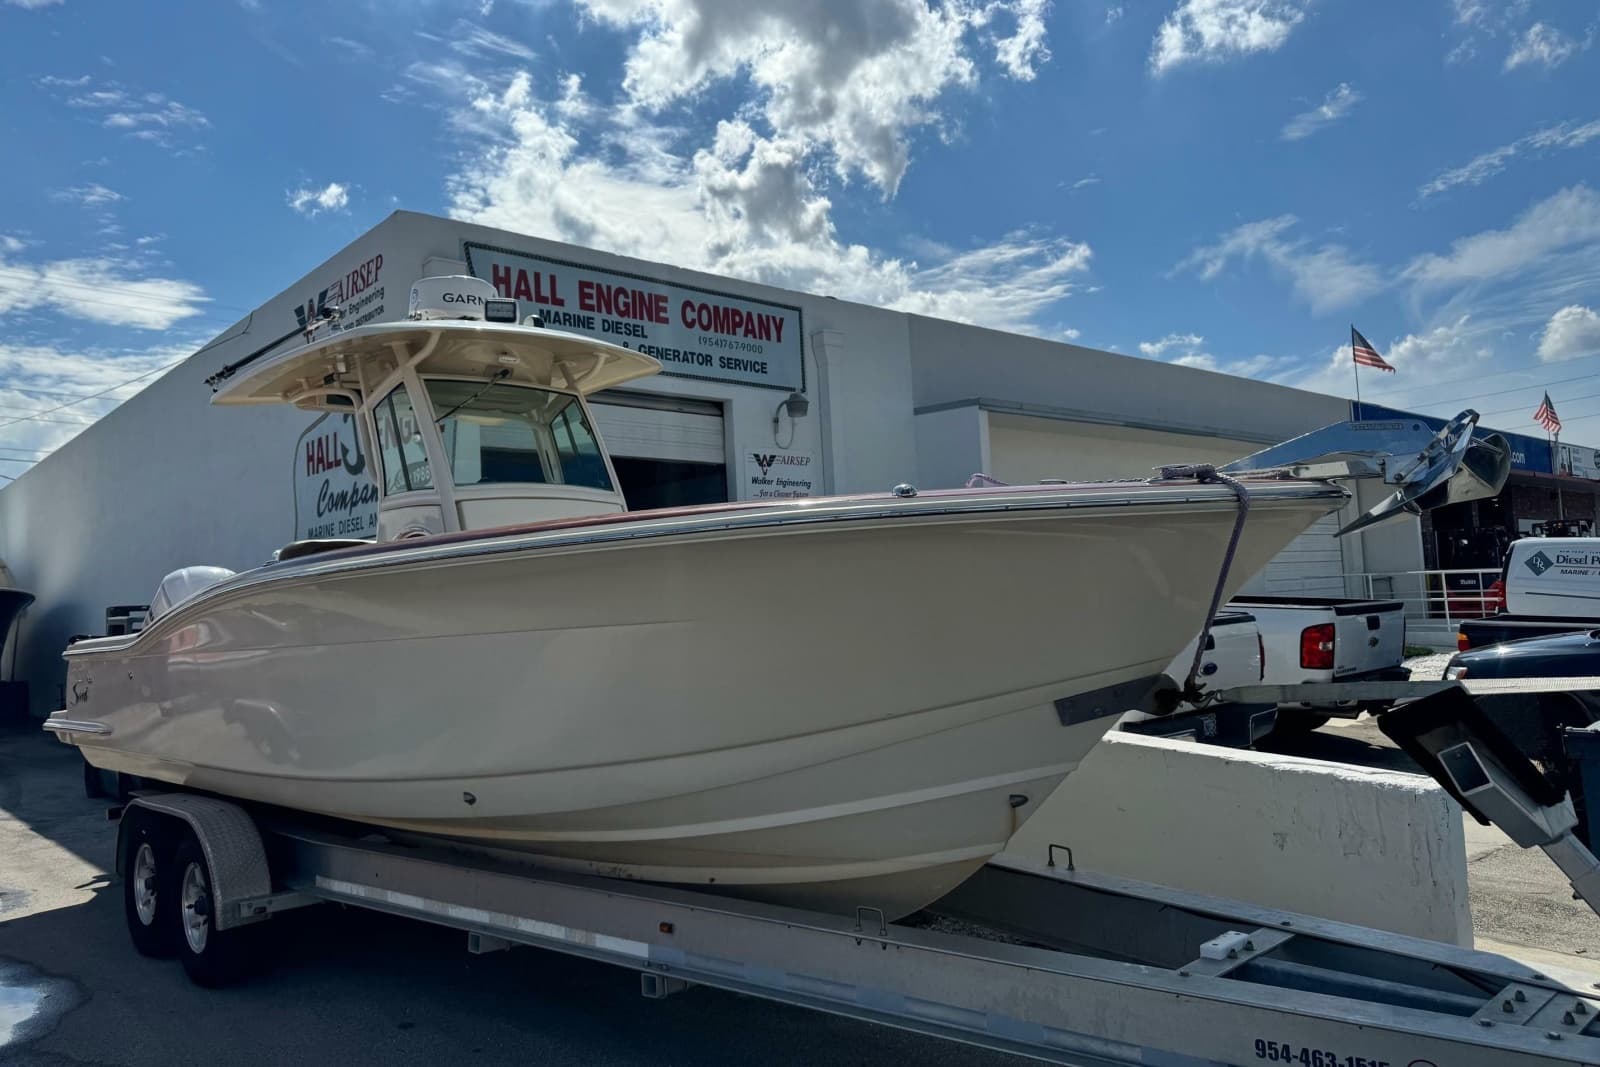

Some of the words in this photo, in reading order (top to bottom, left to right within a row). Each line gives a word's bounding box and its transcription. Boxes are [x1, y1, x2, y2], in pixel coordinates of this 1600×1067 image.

[336, 253, 384, 306] AIRSEP
[492, 264, 565, 307] HALL
[578, 280, 670, 325] ENGINE
[680, 300, 785, 343] COMPANY
[539, 309, 595, 331] MARINE
[602, 318, 648, 339] DIESEL
[638, 344, 713, 367] GENERATOR
[719, 356, 768, 374] SERVICE
[306, 432, 342, 477] HALL
[780, 455, 811, 466] AIRSEP
[752, 476, 774, 486] Walker
[776, 477, 811, 489] Engineering
[317, 479, 378, 518] Compan
[338, 516, 364, 534] DIESEL
[1254, 1038, 1390, 1067] 954-463-15
